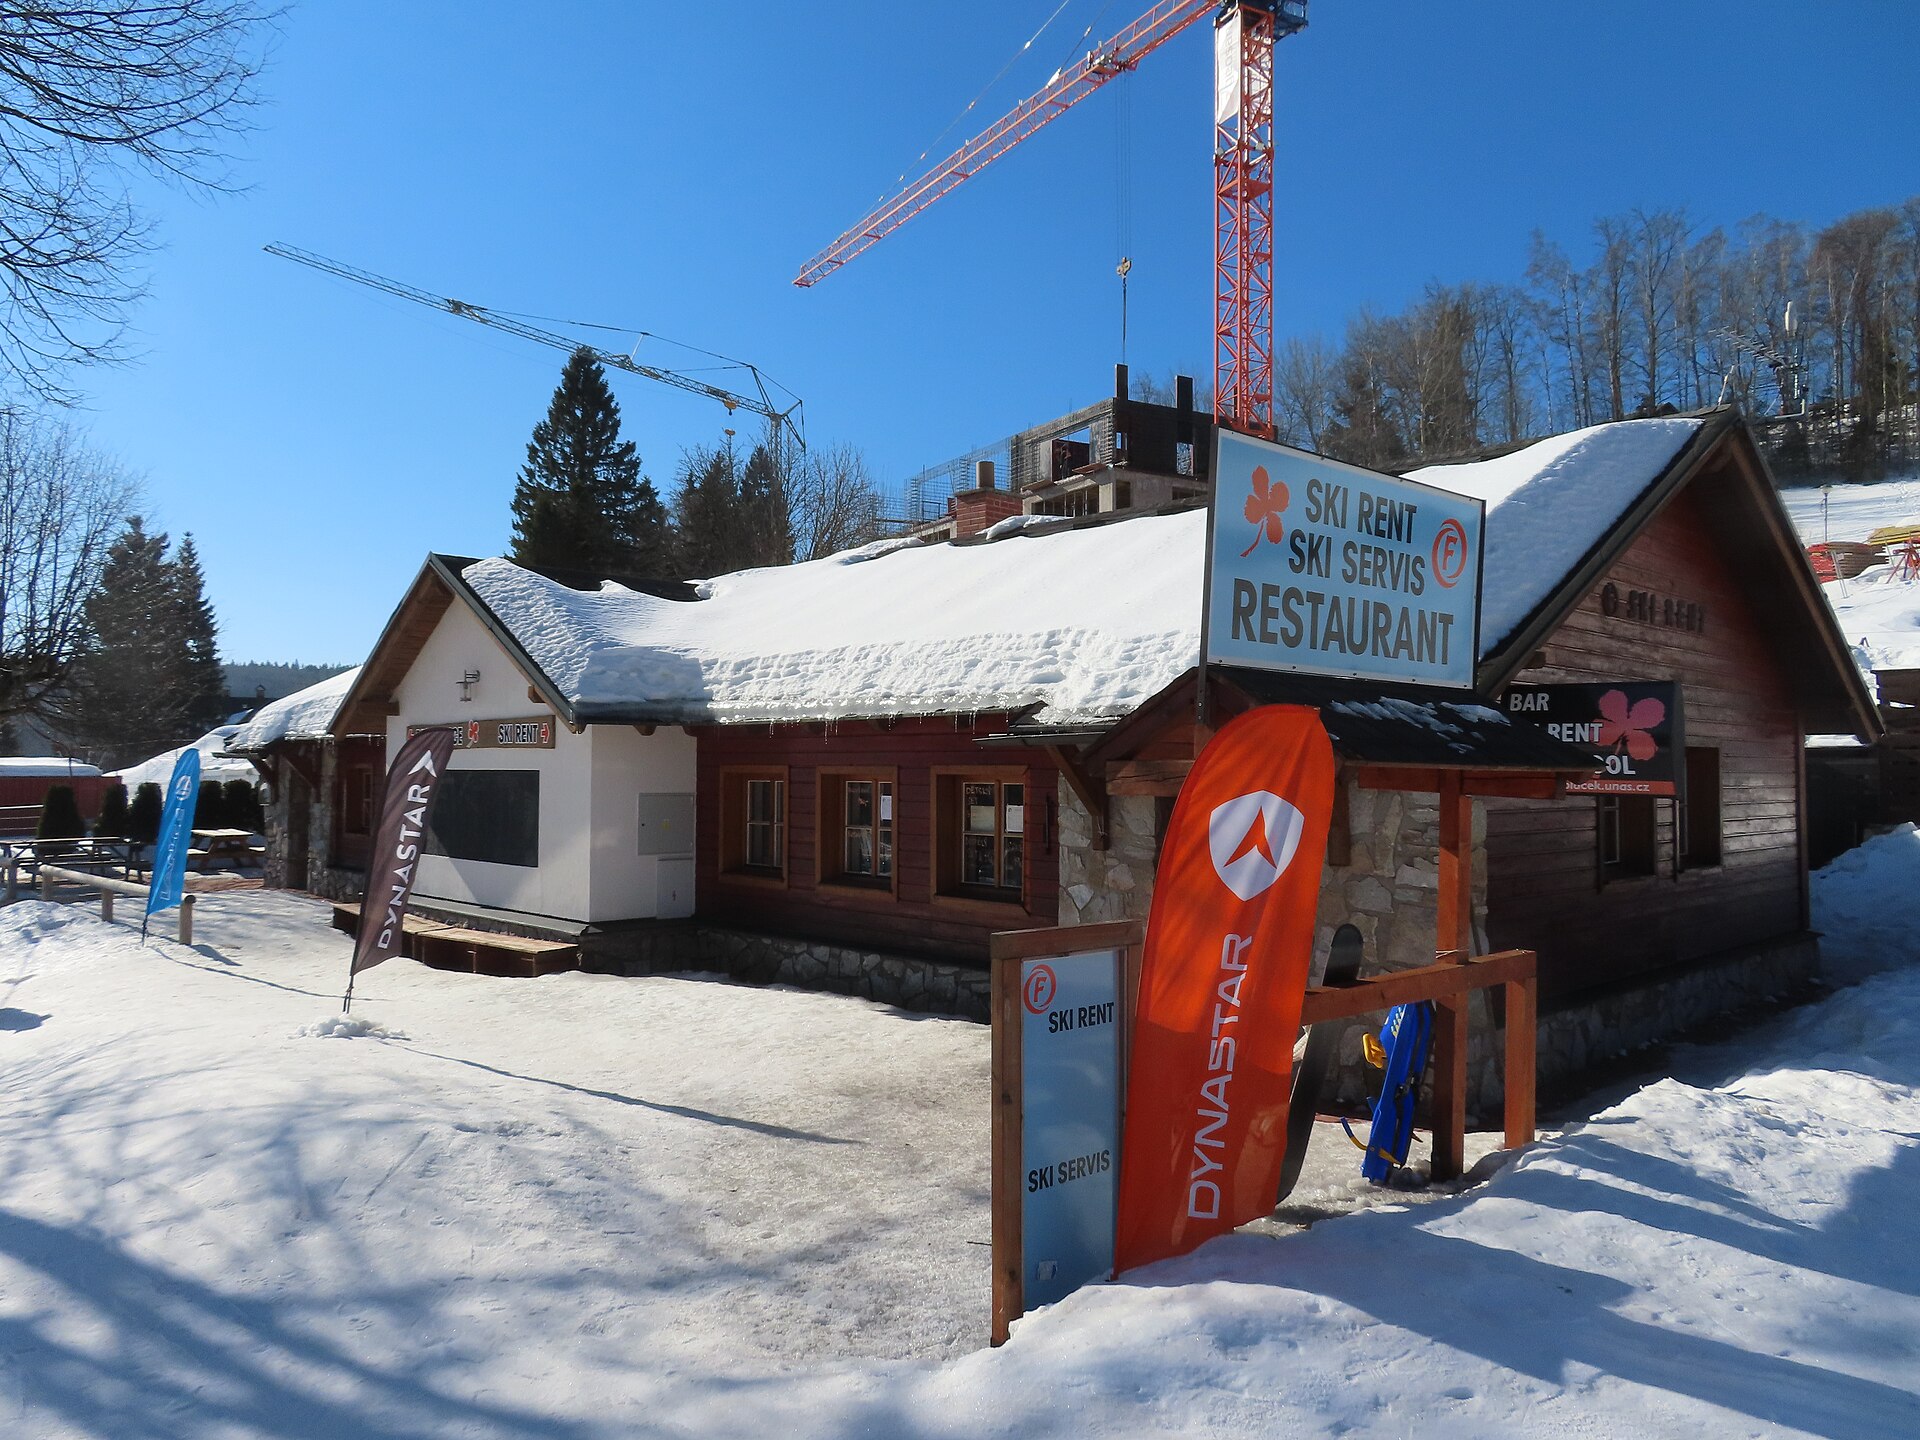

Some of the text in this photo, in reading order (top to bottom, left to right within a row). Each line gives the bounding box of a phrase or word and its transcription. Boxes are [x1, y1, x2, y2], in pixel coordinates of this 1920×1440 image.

[1305, 478, 1418, 544] SKI RENT
[1288, 529, 1426, 596] SKI SERVIS
[1231, 577, 1454, 665] RESTAURANT
[497, 723, 539, 745] SKI RENT
[1509, 692, 1550, 712] BAR
[377, 782, 431, 951] DYNASTAR
[1047, 1002, 1115, 1034] SKI RENT
[1187, 933, 1253, 1220] DYNASTAR
[1027, 1149, 1111, 1193] SKI SERVIS
